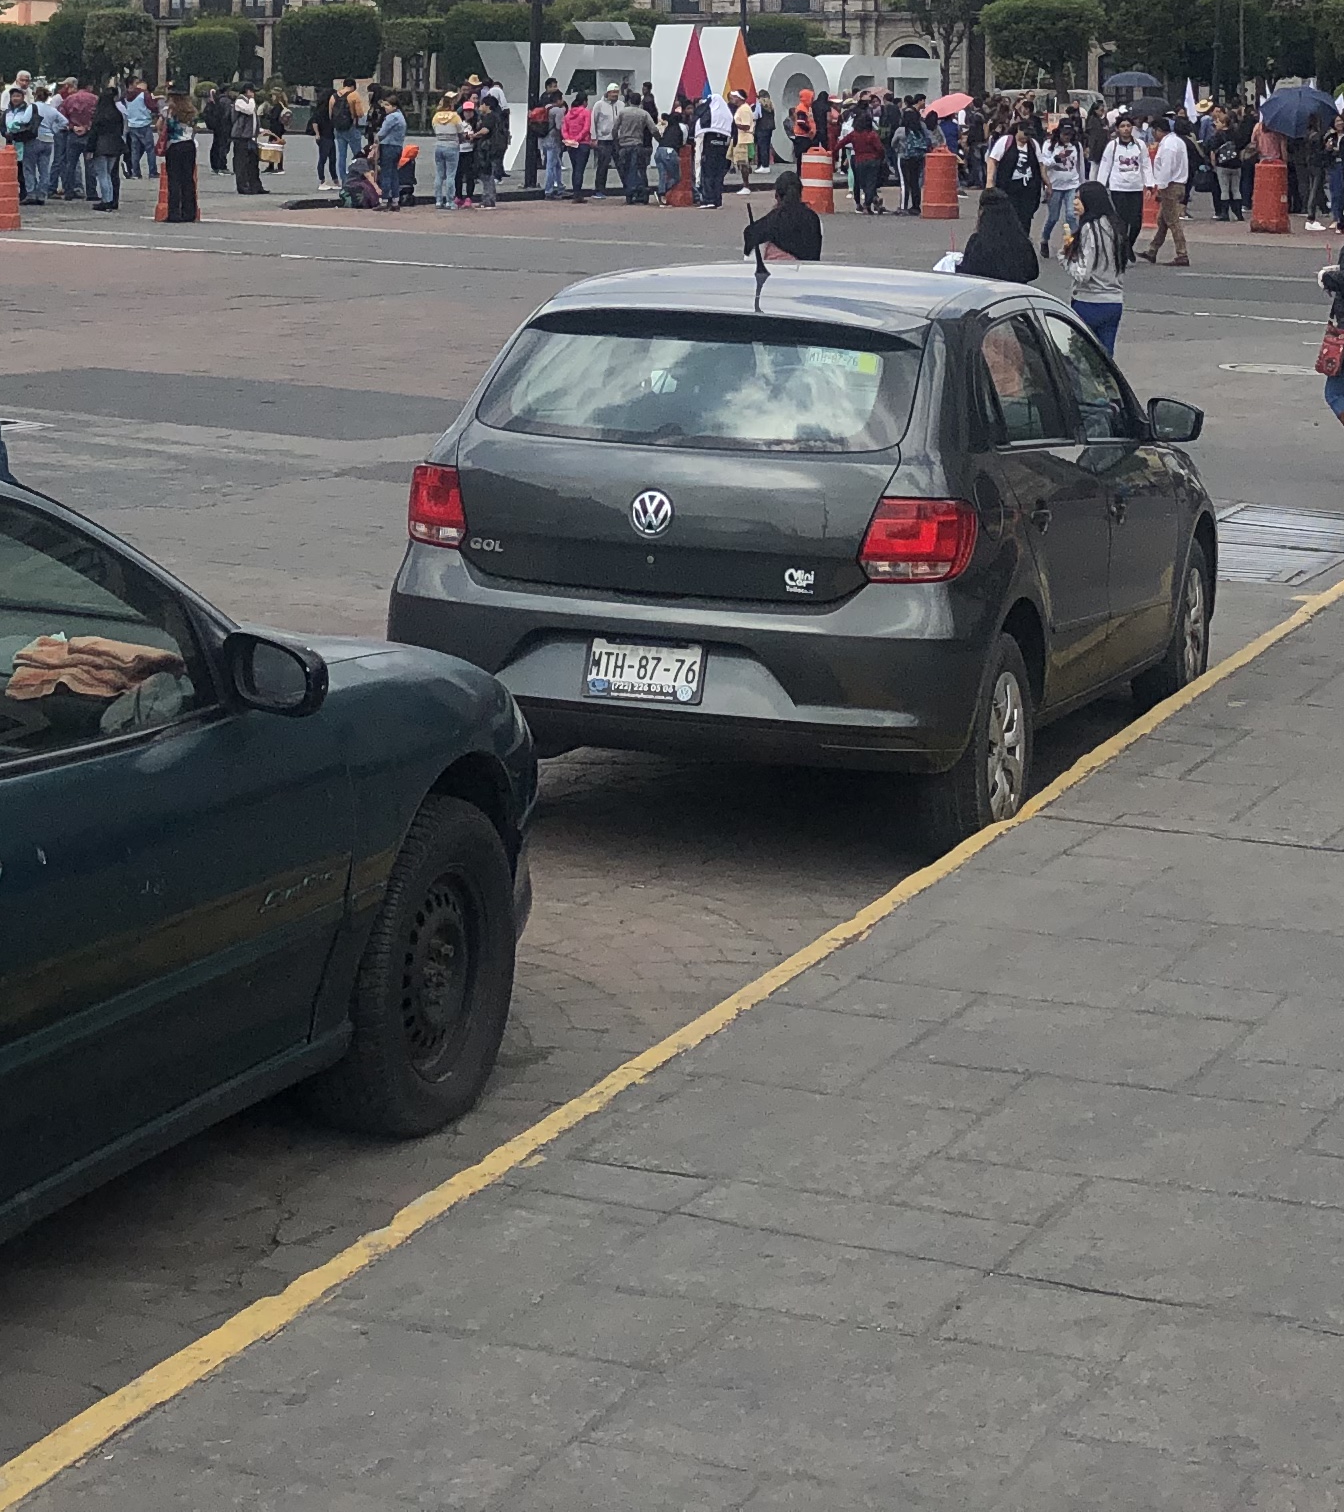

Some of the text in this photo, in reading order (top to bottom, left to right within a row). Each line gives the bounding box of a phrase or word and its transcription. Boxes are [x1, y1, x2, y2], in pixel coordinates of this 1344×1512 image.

[470, 538, 504, 552] GOL
[589, 650, 697, 684] MTH-87-76
[611, 681, 633, 692] (722)
[633, 683, 649, 692] 226
[650, 684, 662, 693] 05
